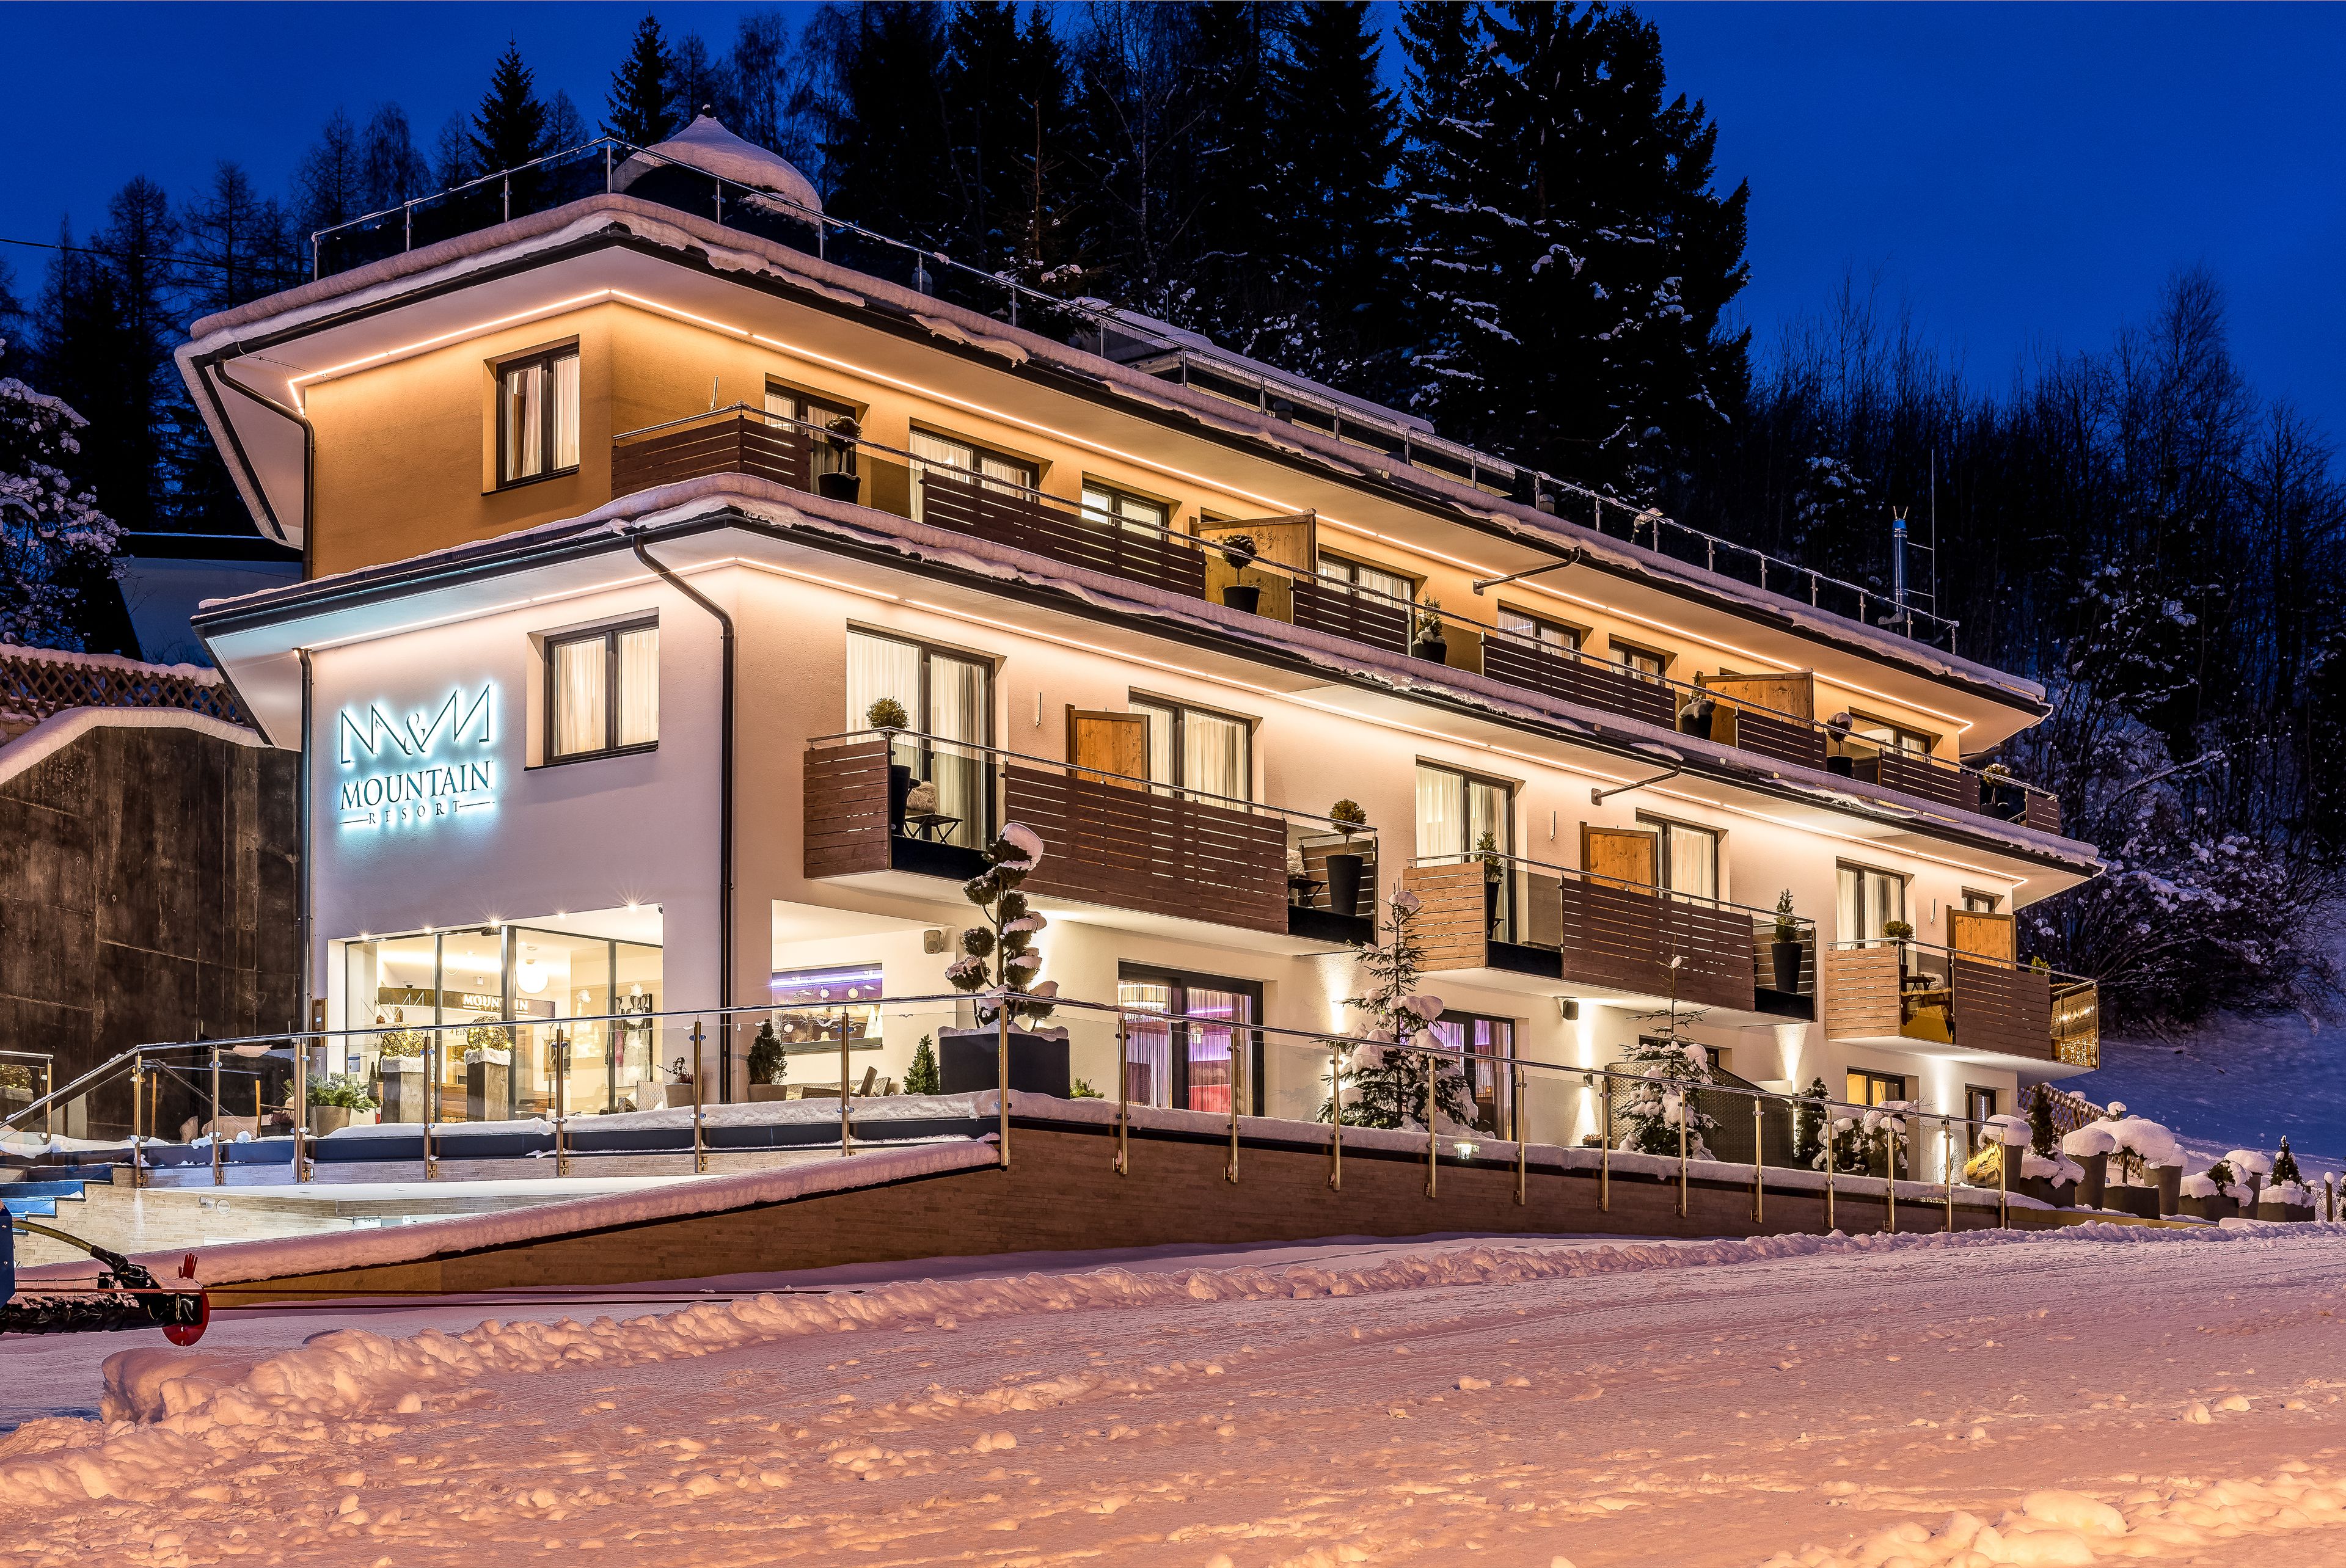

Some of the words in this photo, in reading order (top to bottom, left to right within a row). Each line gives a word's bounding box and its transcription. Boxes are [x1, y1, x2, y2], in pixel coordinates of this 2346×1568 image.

[339, 760, 492, 811] MOUNTAIN
[368, 800, 459, 824] RESORT
[463, 994, 528, 1011] MOUNIN
